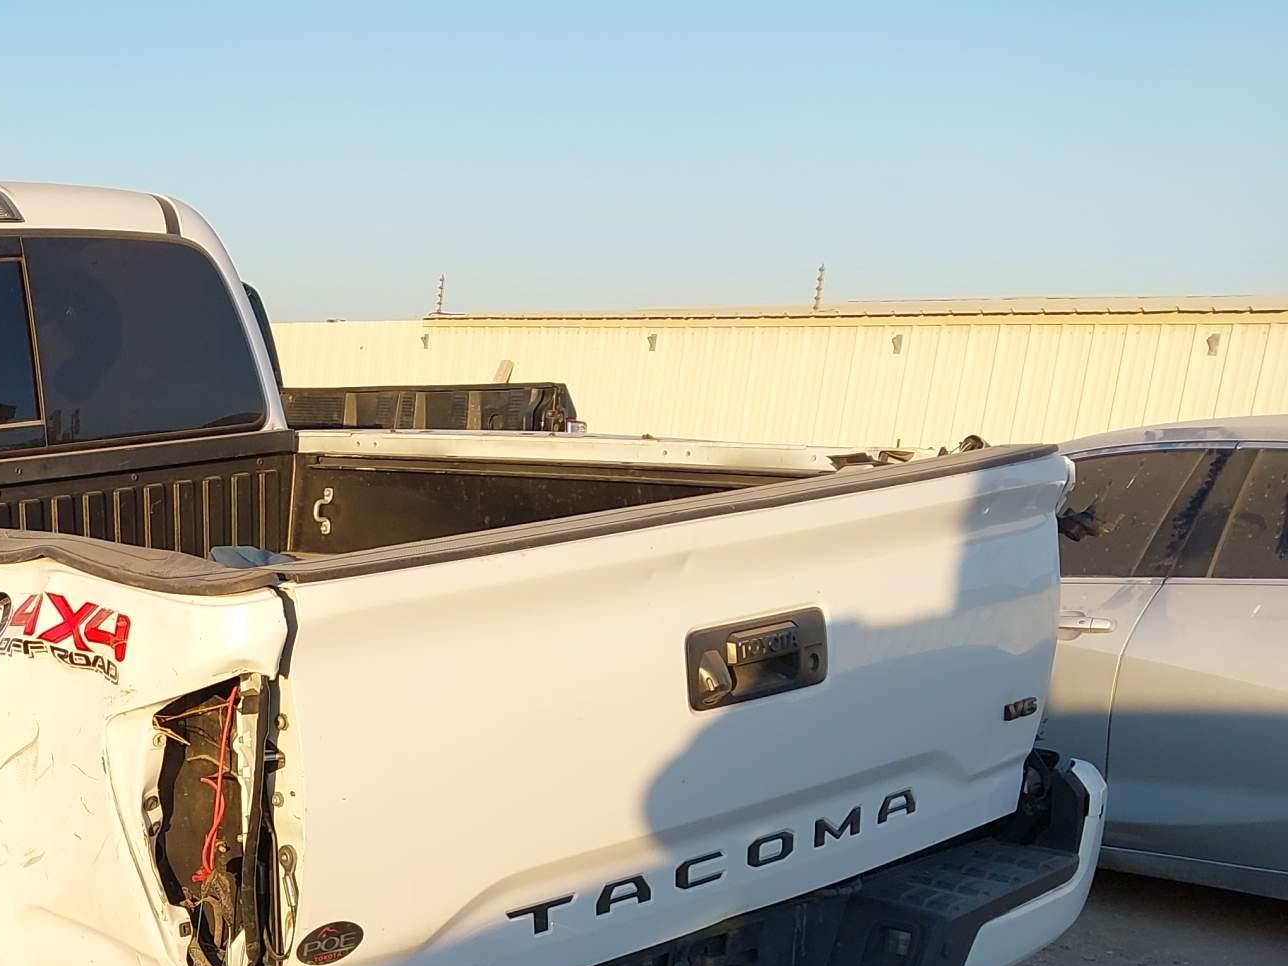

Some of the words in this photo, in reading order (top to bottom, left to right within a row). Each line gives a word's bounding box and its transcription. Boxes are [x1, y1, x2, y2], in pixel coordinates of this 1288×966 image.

[9, 592, 131, 662] 4X4
[738, 631, 798, 660] TOYOTA
[49, 645, 119, 685] ROAD
[1004, 697, 1037, 721] V6
[506, 787, 916, 935] TACOMA
[303, 931, 357, 957] POE
